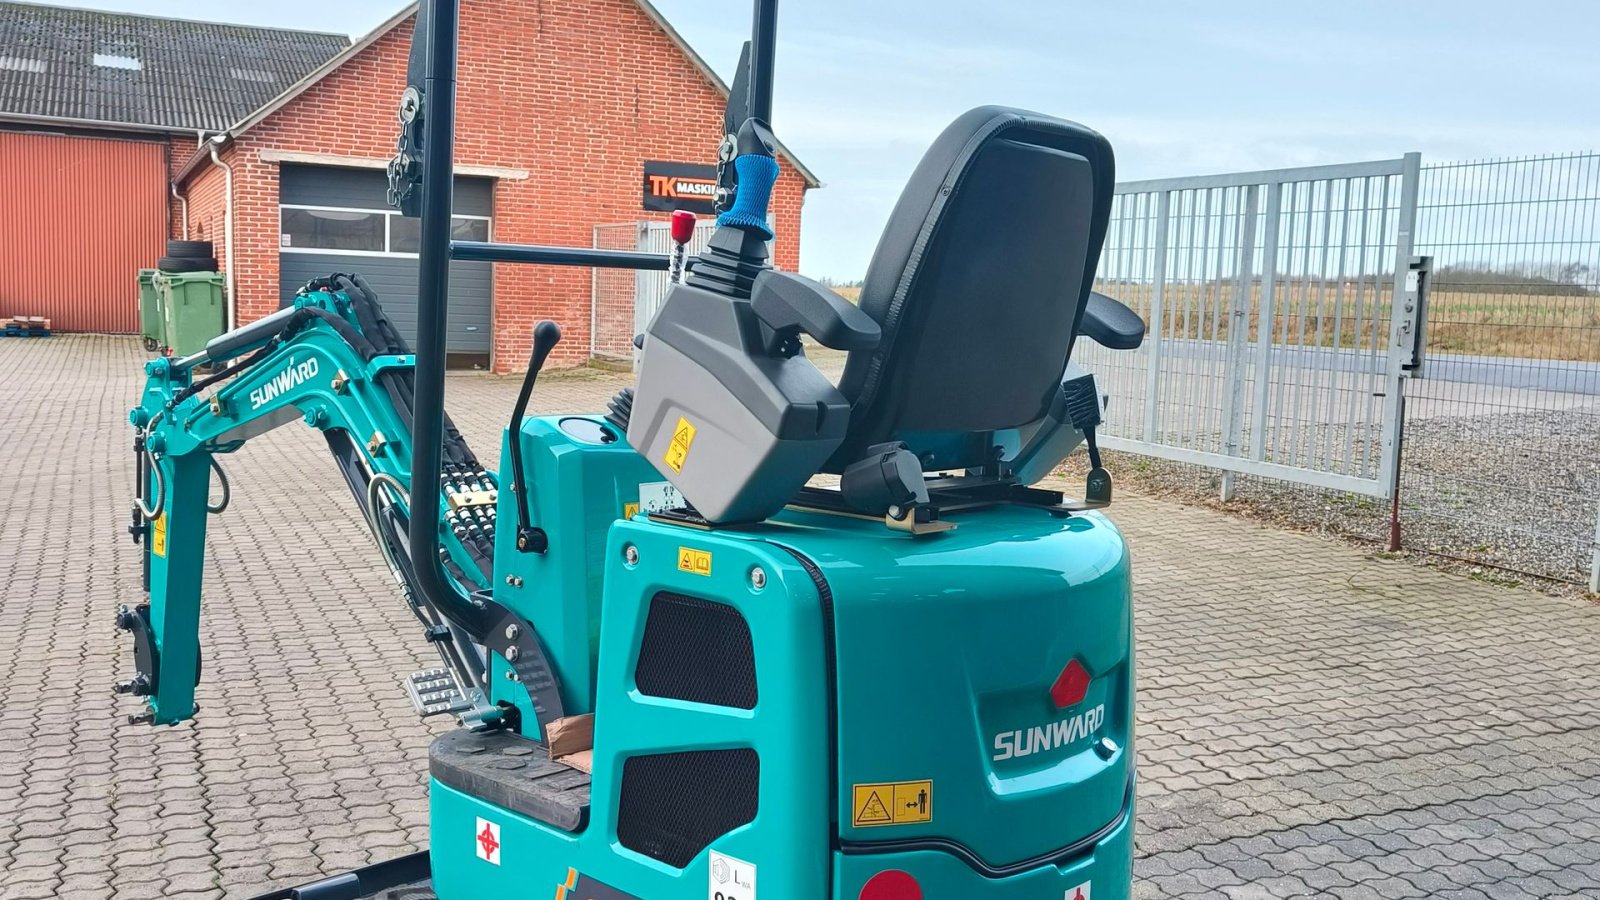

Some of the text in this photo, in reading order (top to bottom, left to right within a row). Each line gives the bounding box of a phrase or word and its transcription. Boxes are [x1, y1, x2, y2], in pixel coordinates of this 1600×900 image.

[649, 175, 677, 197] TK
[250, 356, 319, 410] SUNWARD
[993, 704, 1105, 761] SUNWARD
